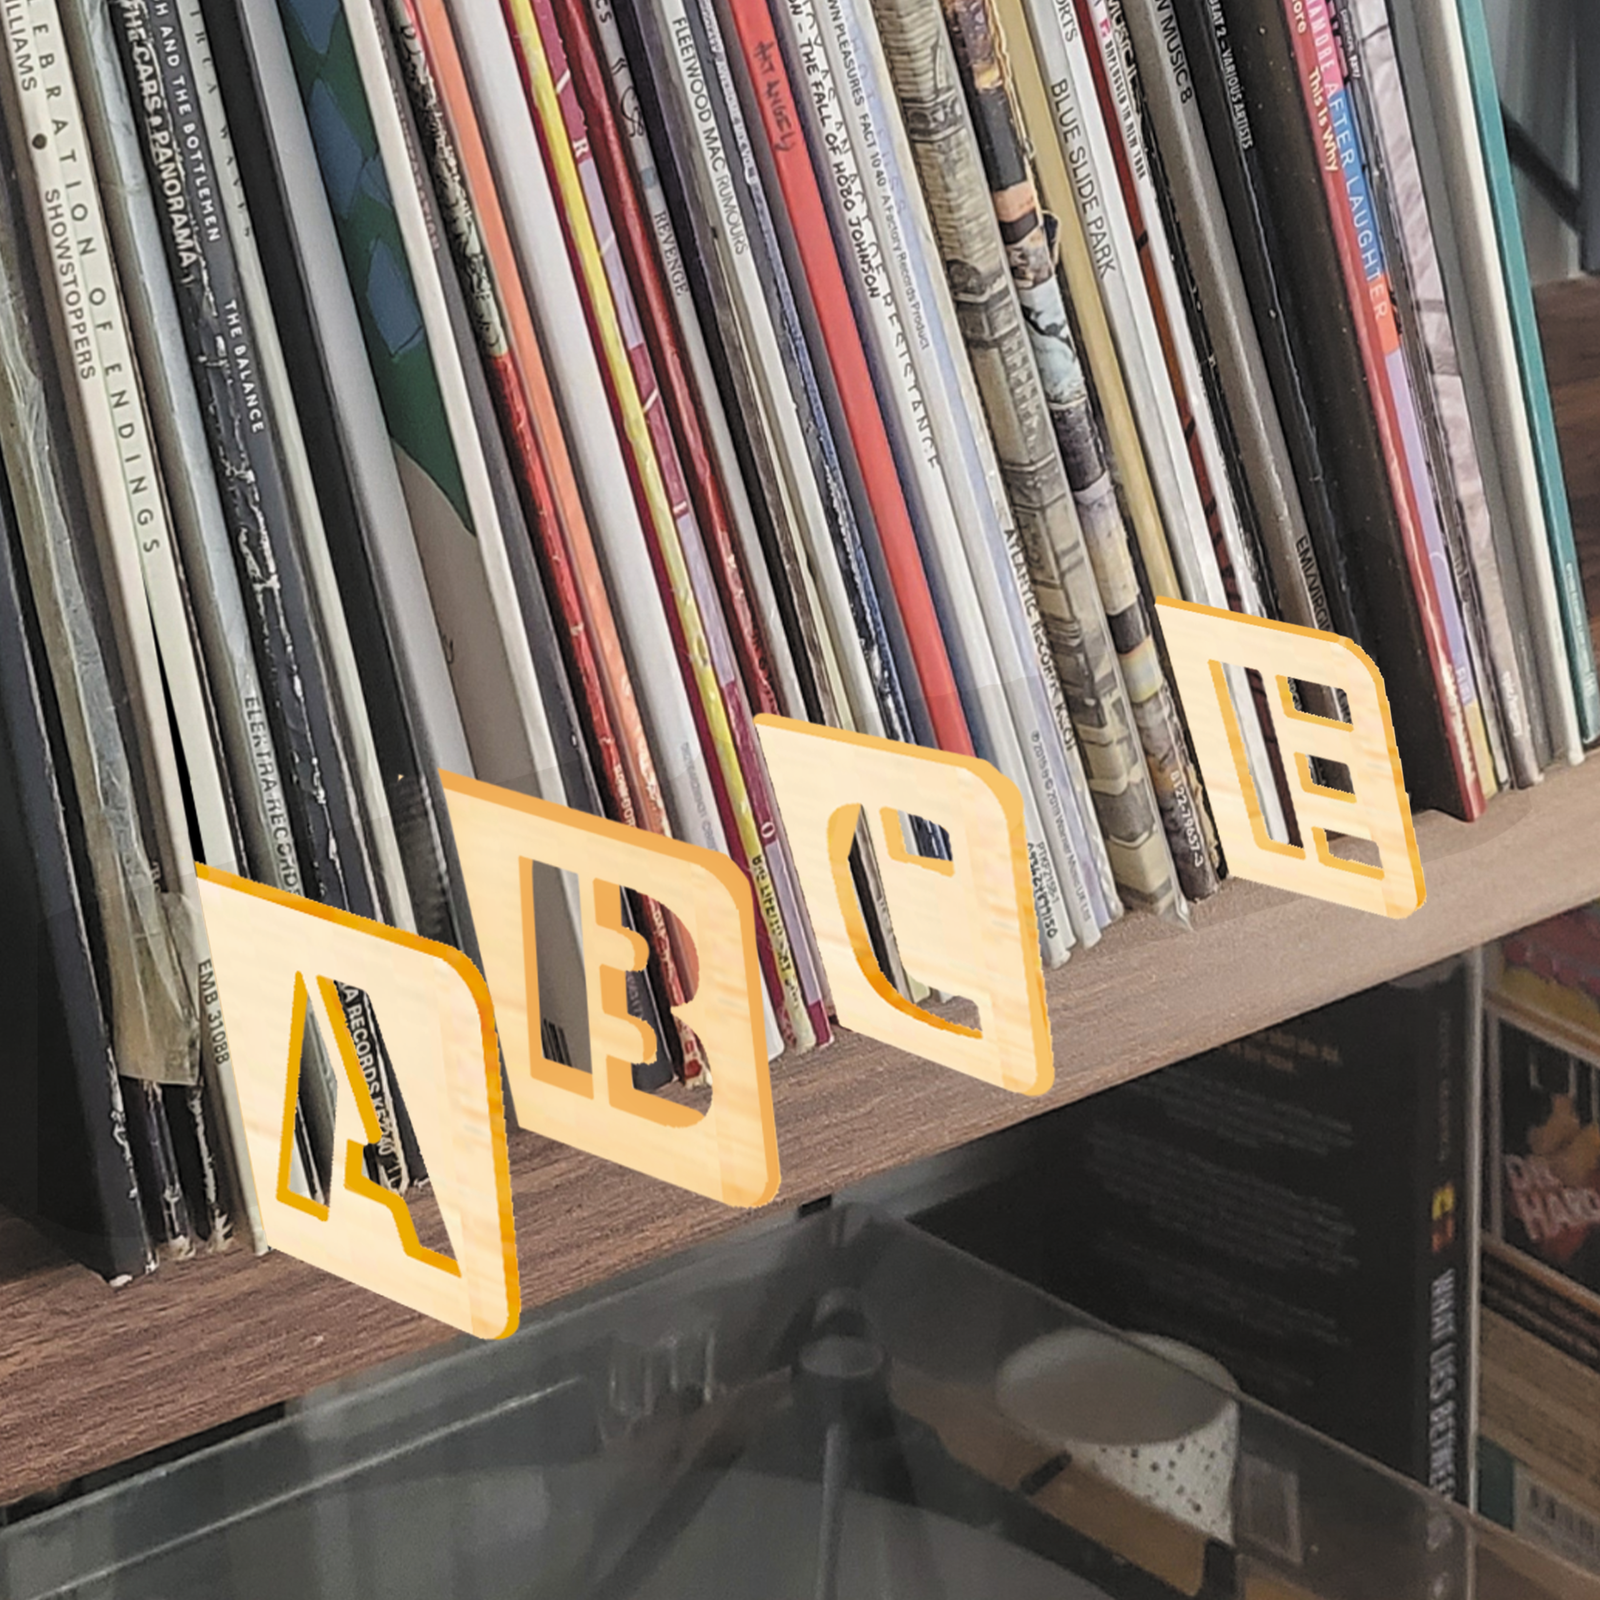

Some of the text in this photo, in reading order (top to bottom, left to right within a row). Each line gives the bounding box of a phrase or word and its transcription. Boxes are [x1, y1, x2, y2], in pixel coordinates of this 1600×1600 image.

[160, 26, 181, 67] AND
[1104, 39, 1127, 106] UNPLUGGED
[1160, 14, 1190, 88] MUSIC
[1180, 87, 1194, 105] 8
[1216, 26, 1227, 38] 2
[1221, 47, 1244, 103] VARIOUS
[171, 76, 193, 116] THE
[1233, 101, 1253, 150] ARTISTS
[1291, 0, 1340, 173] ore This Is Why
[132, 45, 163, 119] CARS
[151, 129, 199, 269] PANORAMA
[672, 17, 748, 255] FLEETWOOD MAC RUMOURS
[799, 36, 816, 73] THE
[811, 74, 832, 127] FALL
[824, 133, 841, 156] OF
[833, 162, 854, 211] HOBO
[848, 215, 881, 298] JOHNSON
[1050, 78, 1117, 280] BLUE SLIDE PARK
[1305, 0, 1390, 320] AMORE AFTER LAUGHTER
[4, 0, 96, 380] LLIAMS SHOWSTOPPERS
[183, 123, 222, 242] BOTTLEMEN
[834, 22, 865, 107] PLEASURES
[858, 113, 878, 154] FACT
[883, 206, 901, 253] Factory
[896, 251, 915, 302] Records
[909, 301, 931, 350] Product
[27, 0, 160, 554] EBRATION OF ENDINGS
[653, 210, 690, 297] REVENGE
[225, 300, 244, 339] THE
[233, 344, 265, 434] BALANCE
[1003, 527, 1035, 617] ATLANTIC
[245, 696, 280, 795] ELEKTRA
[199, 958, 231, 1066] EMB 31088
[1430, 1267, 1456, 1342] WHAT
[1429, 1343, 1456, 1400] LIES
